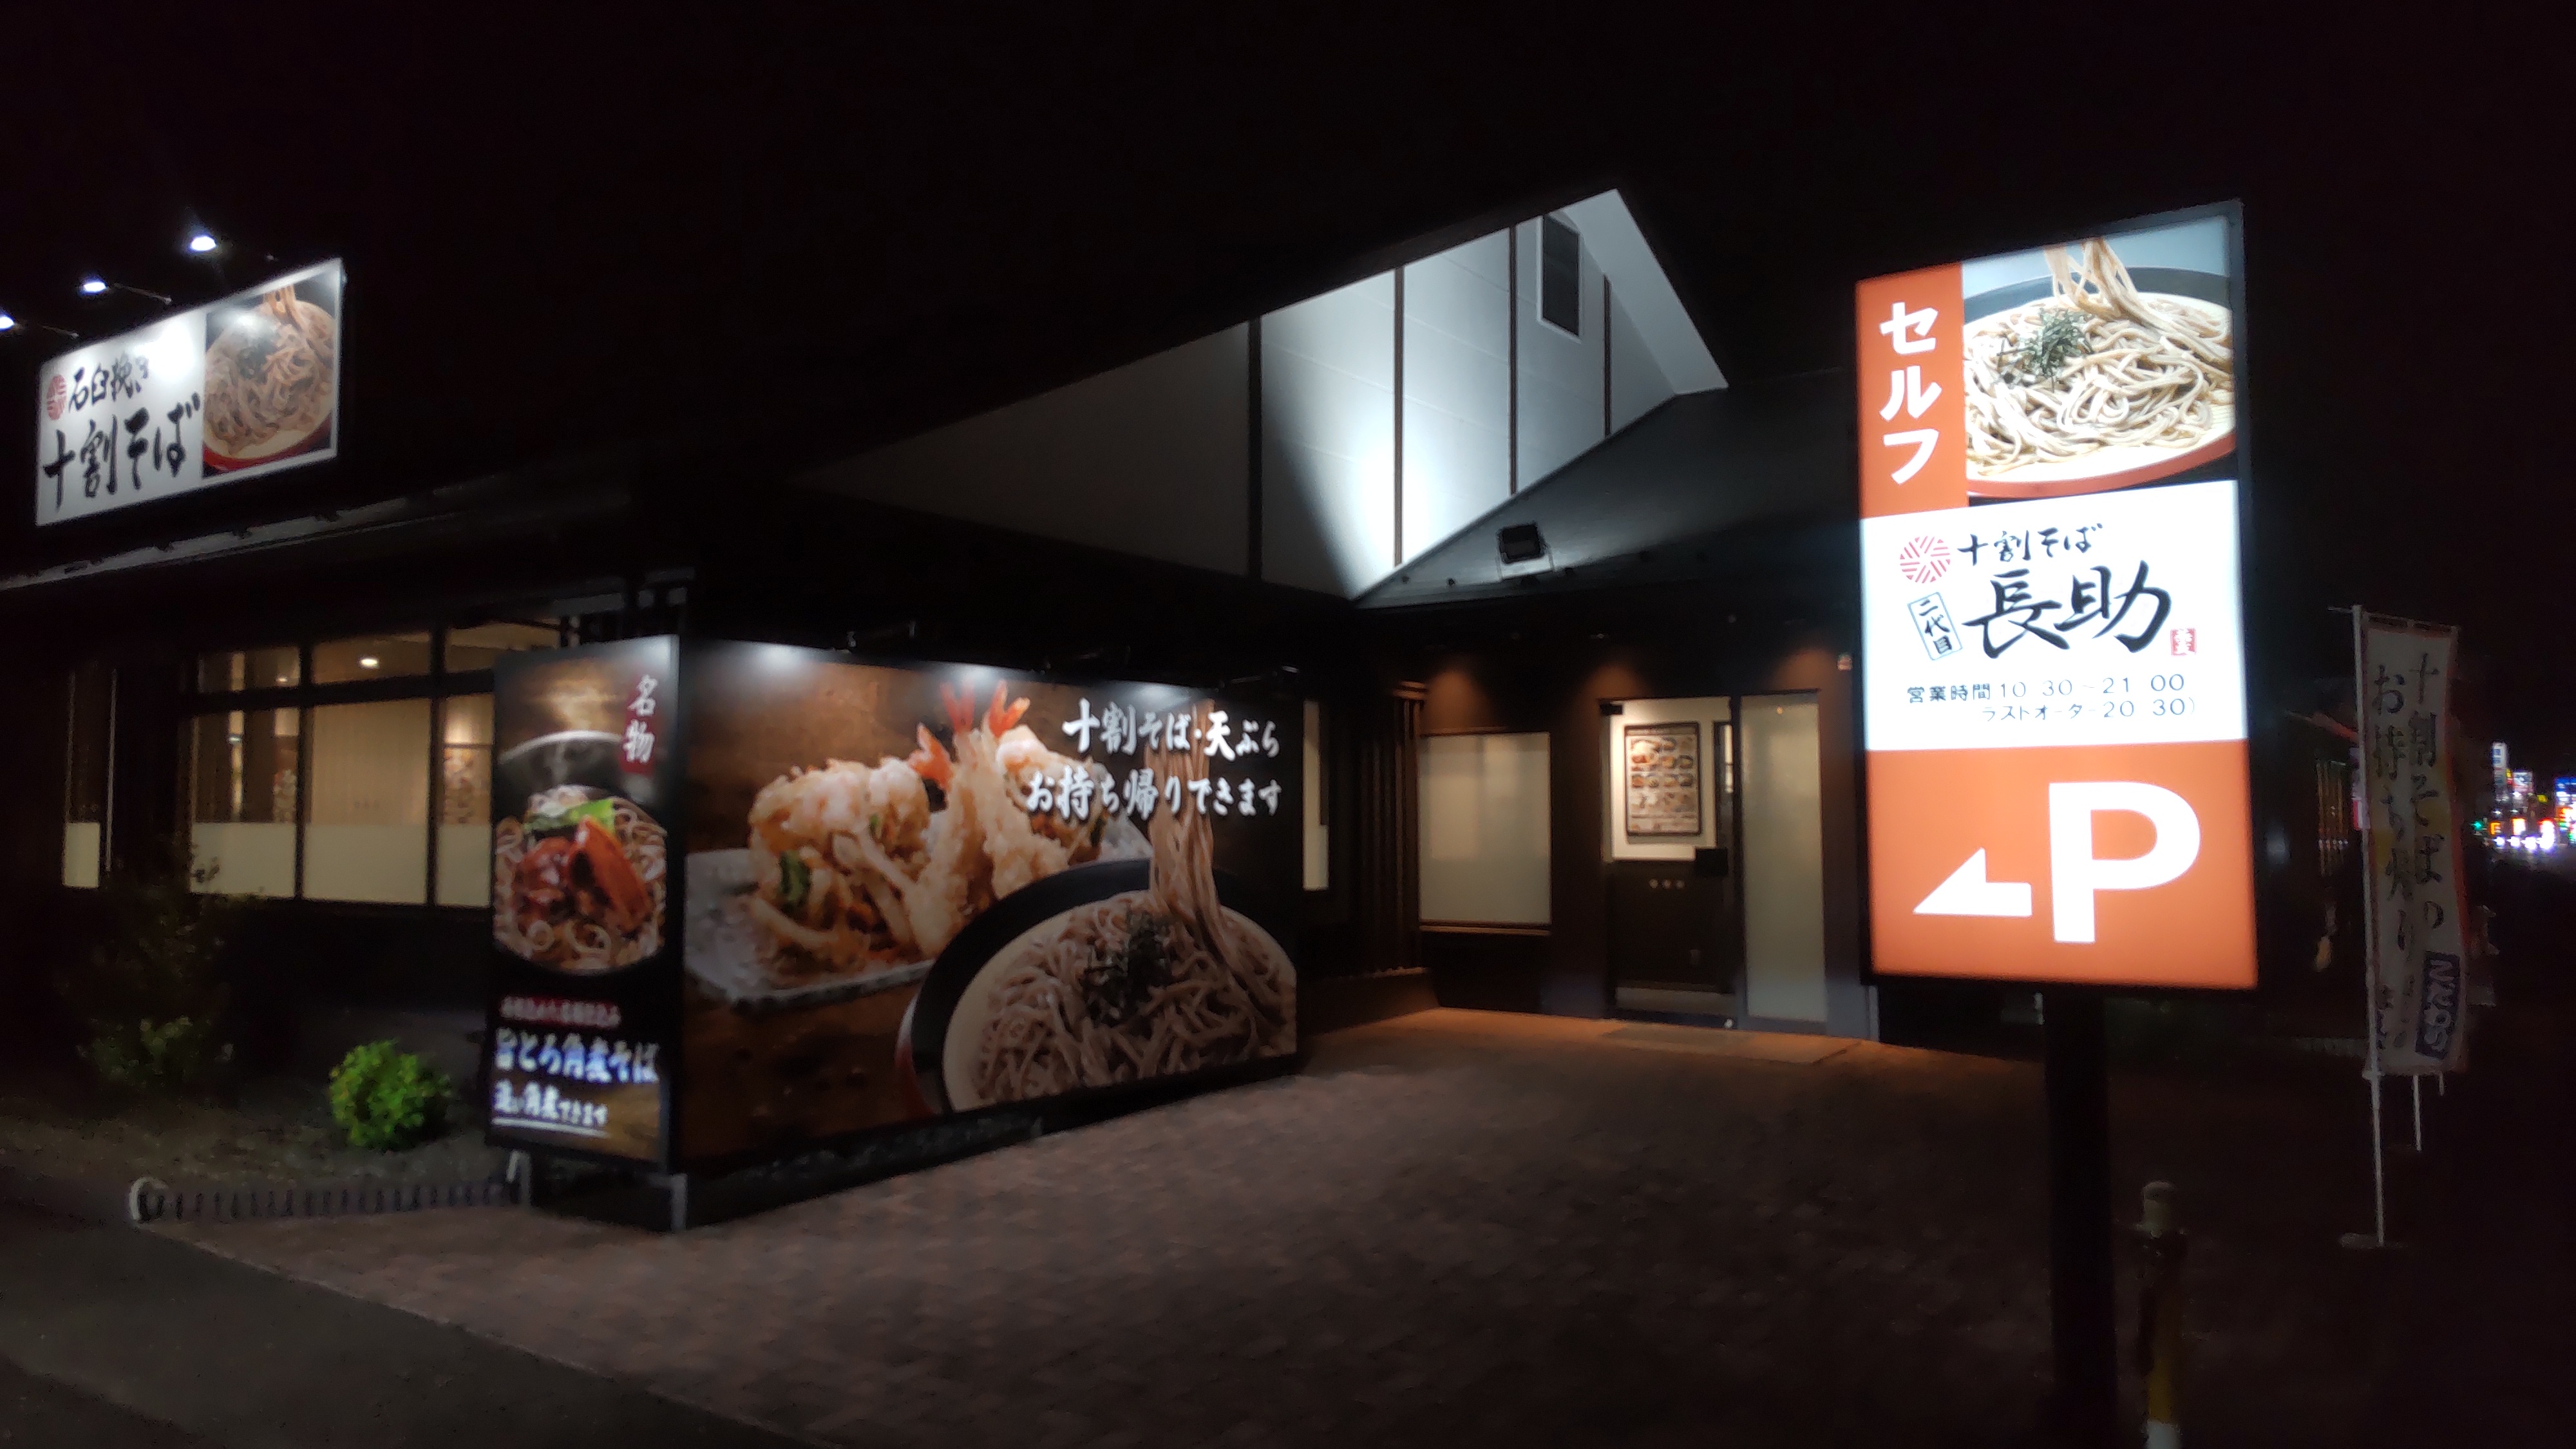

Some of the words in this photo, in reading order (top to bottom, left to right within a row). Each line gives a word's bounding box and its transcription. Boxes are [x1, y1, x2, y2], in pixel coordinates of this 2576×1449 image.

[1879, 301, 1942, 484] セルフ
[44, 392, 201, 509] 十割そば
[1957, 524, 2103, 565] 十割そば
[1918, 599, 1952, 654] 二代目
[1962, 560, 2172, 658] 長助
[622, 674, 659, 762] 名物
[1027, 764, 1282, 821] お持ち帰りできます
[2049, 781, 2200, 943] P
